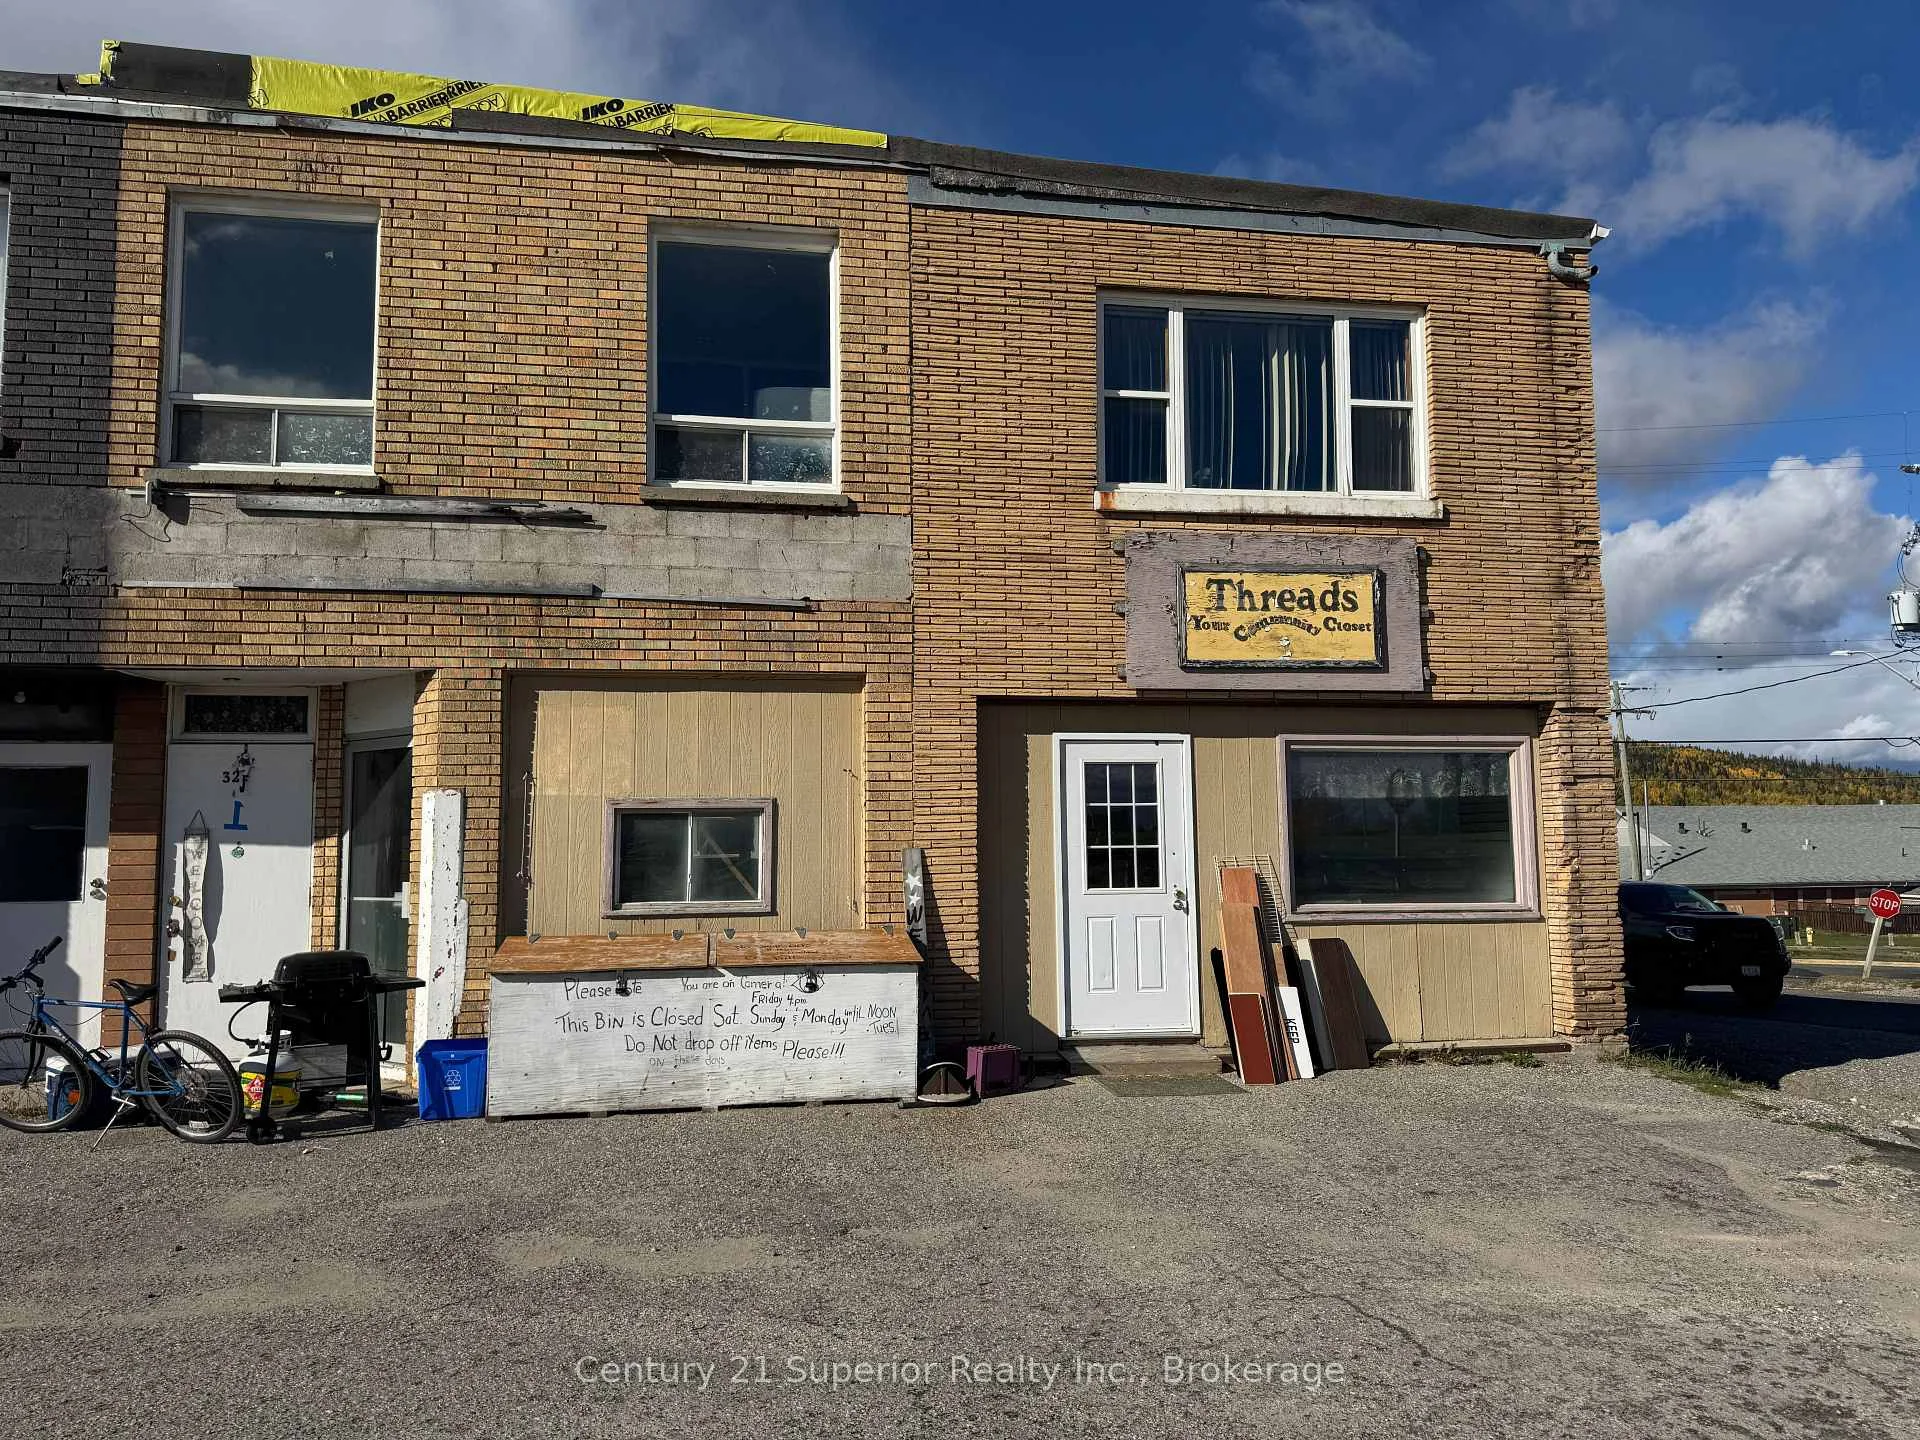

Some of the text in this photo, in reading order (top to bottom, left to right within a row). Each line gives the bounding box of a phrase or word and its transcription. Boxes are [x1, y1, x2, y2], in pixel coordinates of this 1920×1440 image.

[351, 93, 395, 117] IKO
[582, 98, 624, 121] IKO
[1206, 577, 1360, 613] Threads
[1189, 614, 1230, 632] Your
[1323, 616, 1373, 632] Closet
[1871, 896, 1899, 911] STOP
[564, 978, 611, 1000] Please
[682, 977, 698, 992] You
[702, 980, 719, 989] are
[722, 979, 735, 988] on
[555, 1012, 589, 1033] This
[633, 1012, 645, 1027] is
[651, 1006, 704, 1027] Closed
[750, 1004, 786, 1033] Sunday
[801, 1008, 849, 1035] Monday
[624, 1031, 845, 1060] Do Not drop off items Please!!!
